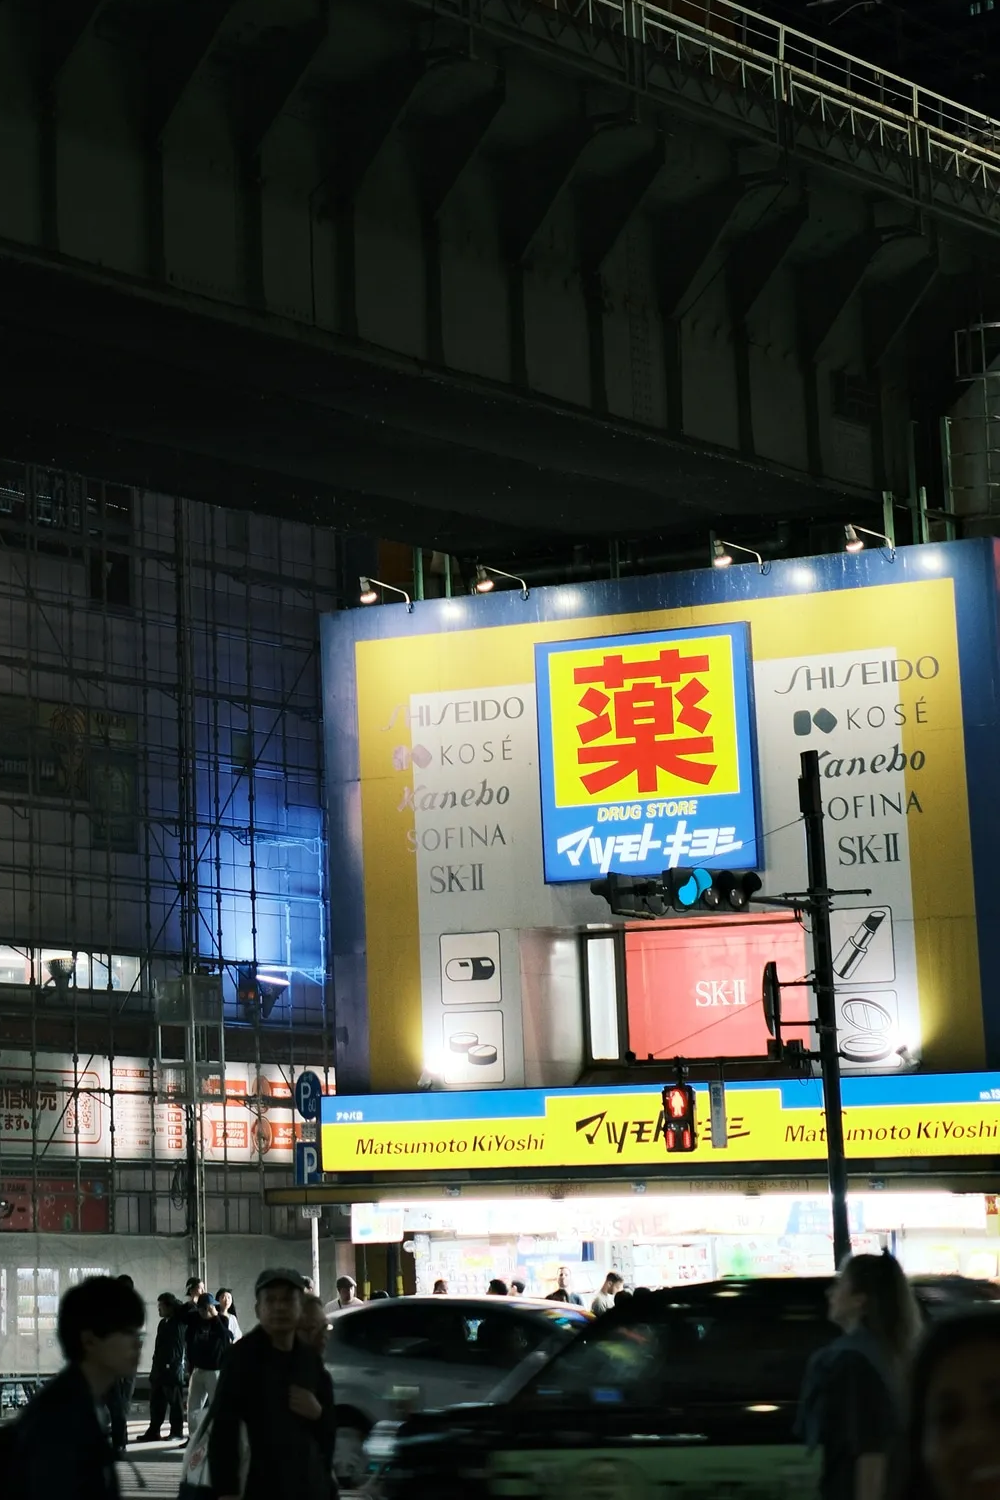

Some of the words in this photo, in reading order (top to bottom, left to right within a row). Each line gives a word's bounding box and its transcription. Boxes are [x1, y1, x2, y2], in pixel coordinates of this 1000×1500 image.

[774, 655, 940, 695] SHISEIDO
[380, 696, 525, 732] SHISEIDO
[573, 649, 718, 795] 薬
[846, 696, 929, 731] KOSÉ
[440, 734, 513, 766] KOSÉ
[397, 778, 511, 812] Kanebo
[597, 804, 642, 823] DRUG
[646, 799, 699, 818] STORE
[827, 789, 924, 821] OFINA
[406, 823, 507, 852] SOFINA
[838, 832, 901, 866] SK-II
[429, 863, 485, 894] SK-II
[695, 979, 748, 1007] SK-II
[355, 1136, 468, 1156] Matsumoto
[472, 1133, 545, 1153] KiYoshi
[784, 1124, 911, 1143] Matumoto
[303, 1147, 317, 1185] P
